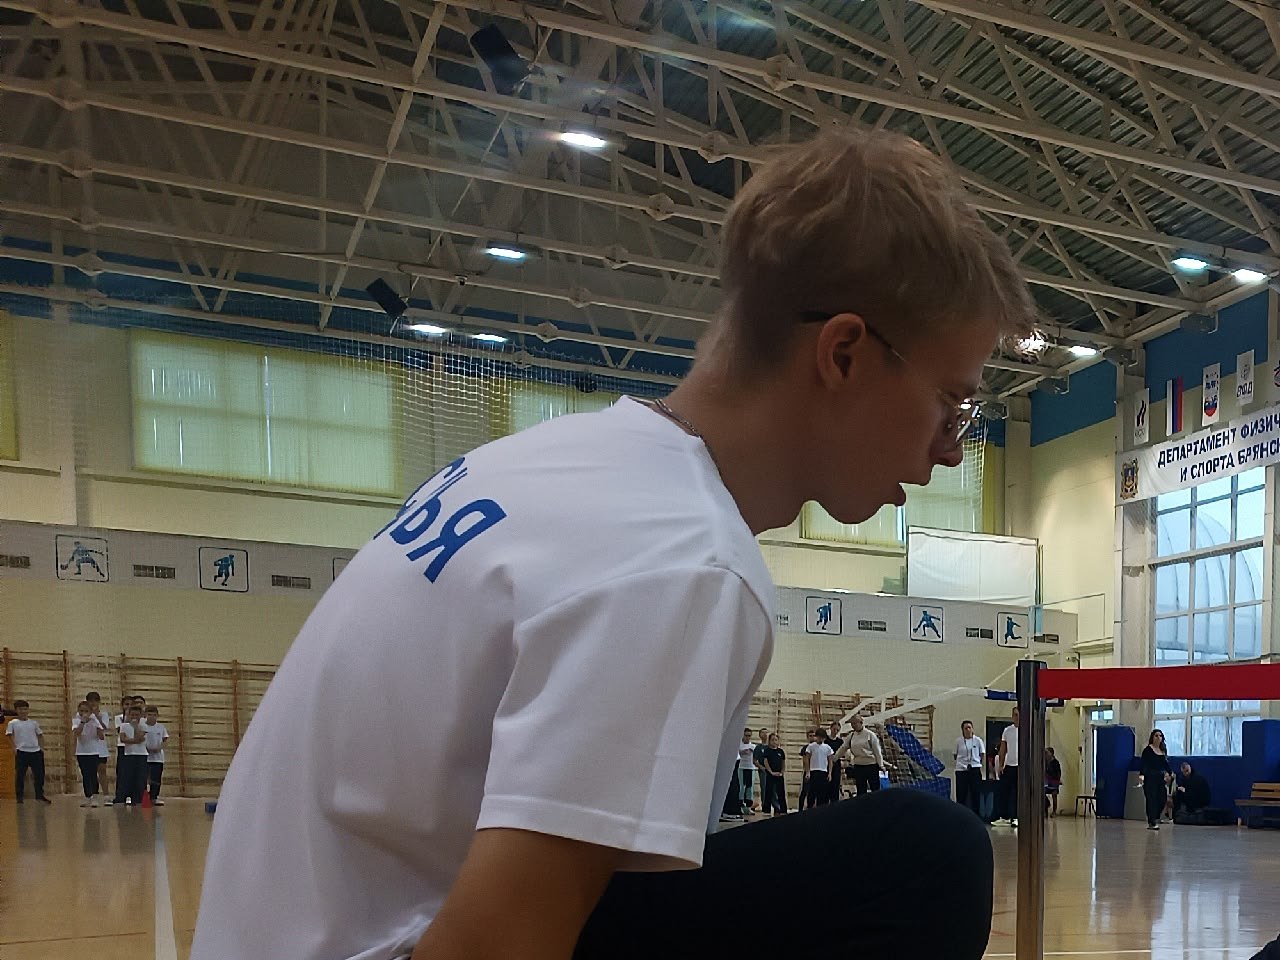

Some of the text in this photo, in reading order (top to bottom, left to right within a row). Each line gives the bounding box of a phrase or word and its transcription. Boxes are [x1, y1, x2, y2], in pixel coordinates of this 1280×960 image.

[1158, 427, 1237, 468] ДЕПАРТАМЕНТ
[1180, 467, 1188, 482] И
[1190, 452, 1236, 480] СПОРТА
